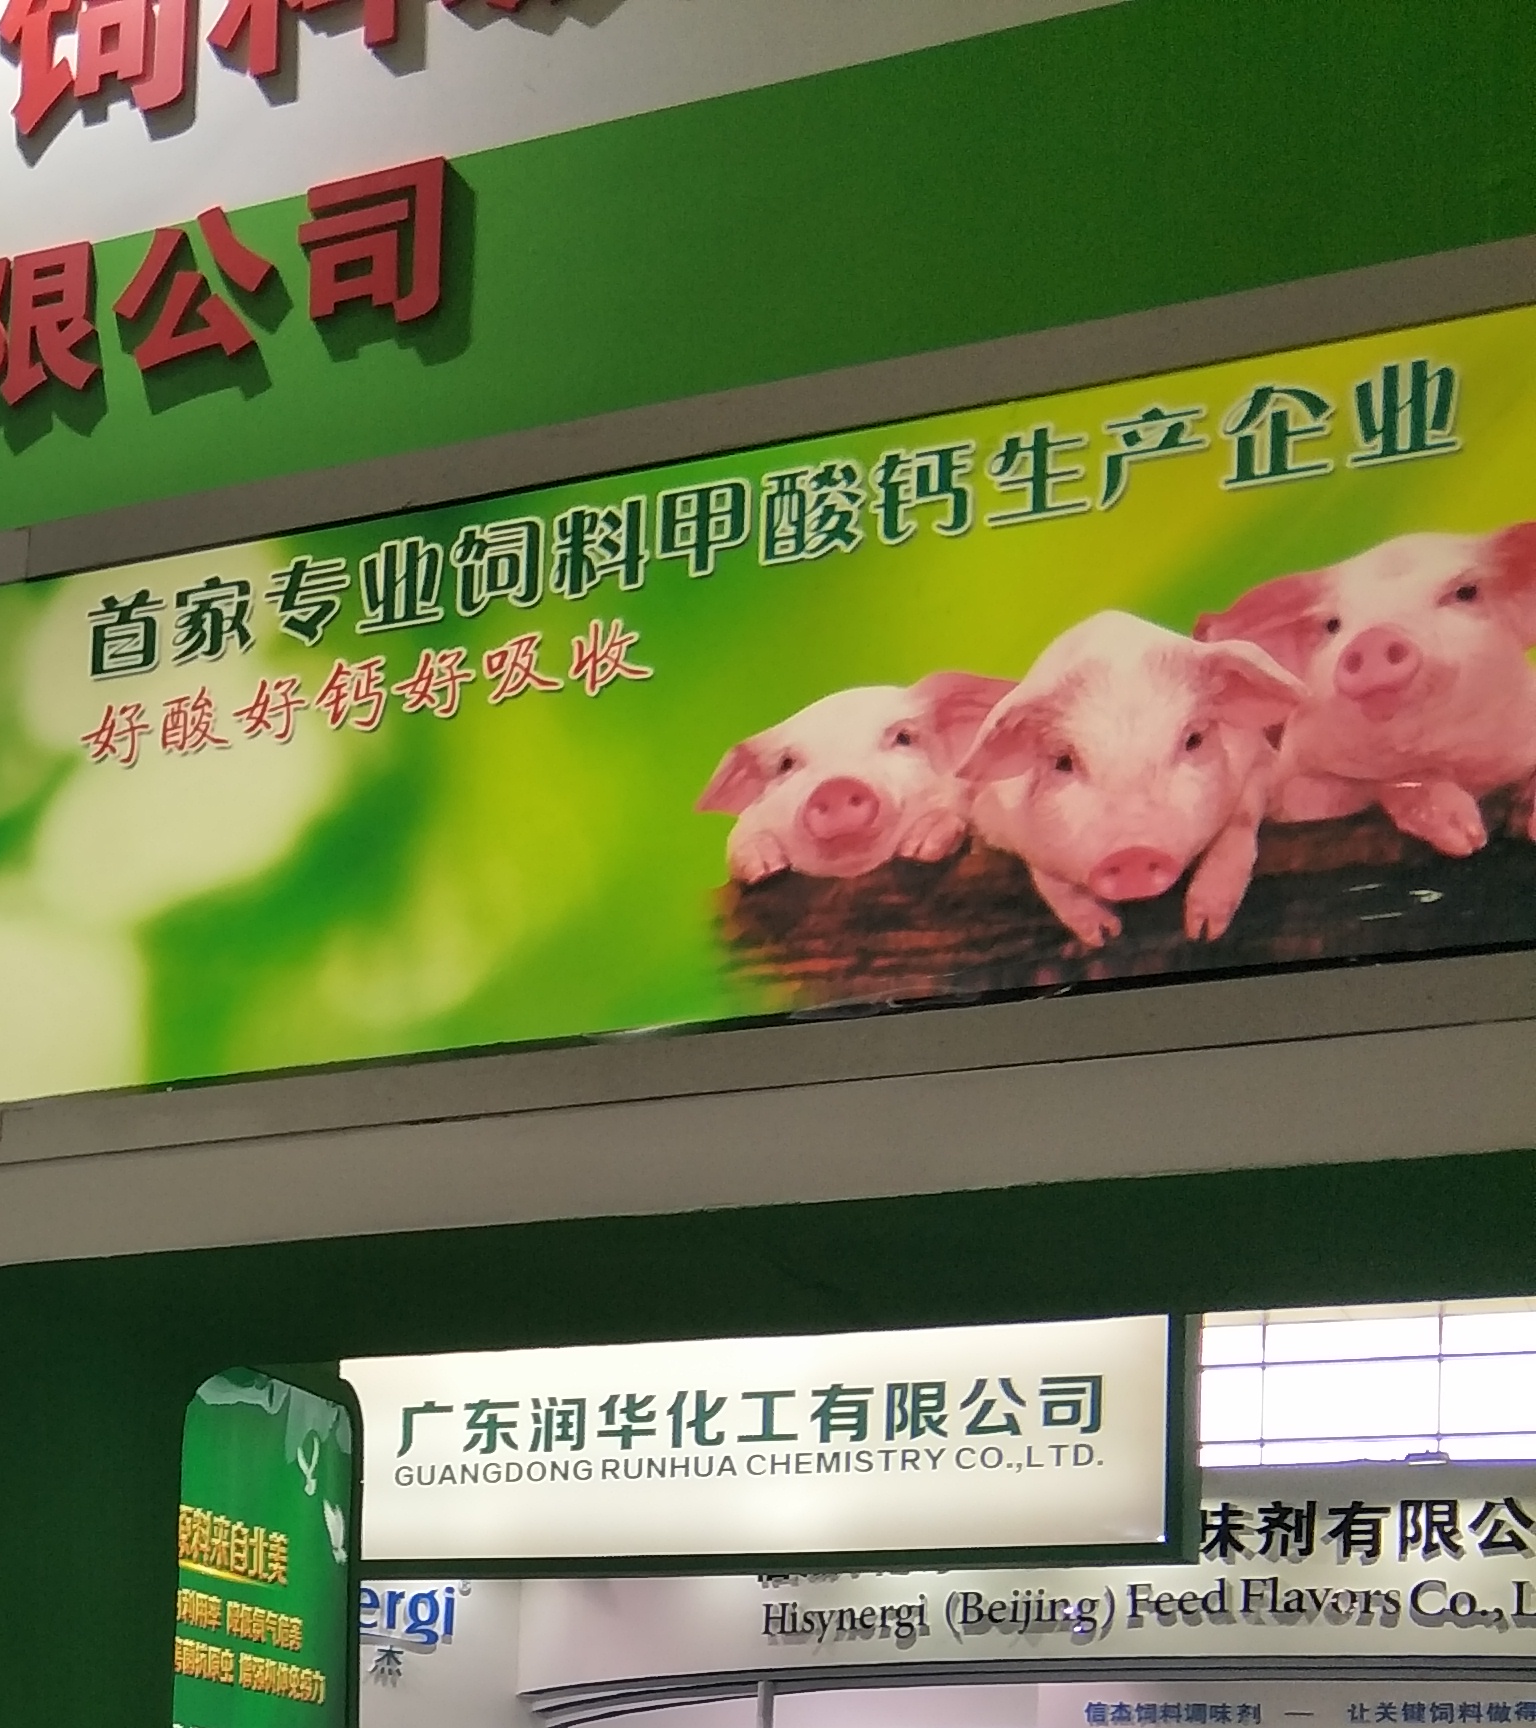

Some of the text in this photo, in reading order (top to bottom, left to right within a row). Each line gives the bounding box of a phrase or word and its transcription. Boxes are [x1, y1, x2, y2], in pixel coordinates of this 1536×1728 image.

[85, 358, 1460, 680] 首家专业饲料甲酸钙生产企业
[81, 618, 652, 768] 好酸好钙好吸收
[396, 1374, 1103, 1458] 广东润华化工有限公司
[394, 1459, 593, 1487] GUANGDONG
[601, 1455, 738, 1481] RUNHUA
[746, 1447, 946, 1476] CHEMISTRY
[762, 1593, 927, 1644] Hisynergi
[1127, 1577, 1228, 1619] Feed
[1240, 1576, 1402, 1618] Flavors
[1085, 1701, 1262, 1726] 信杰饲料调味剂
